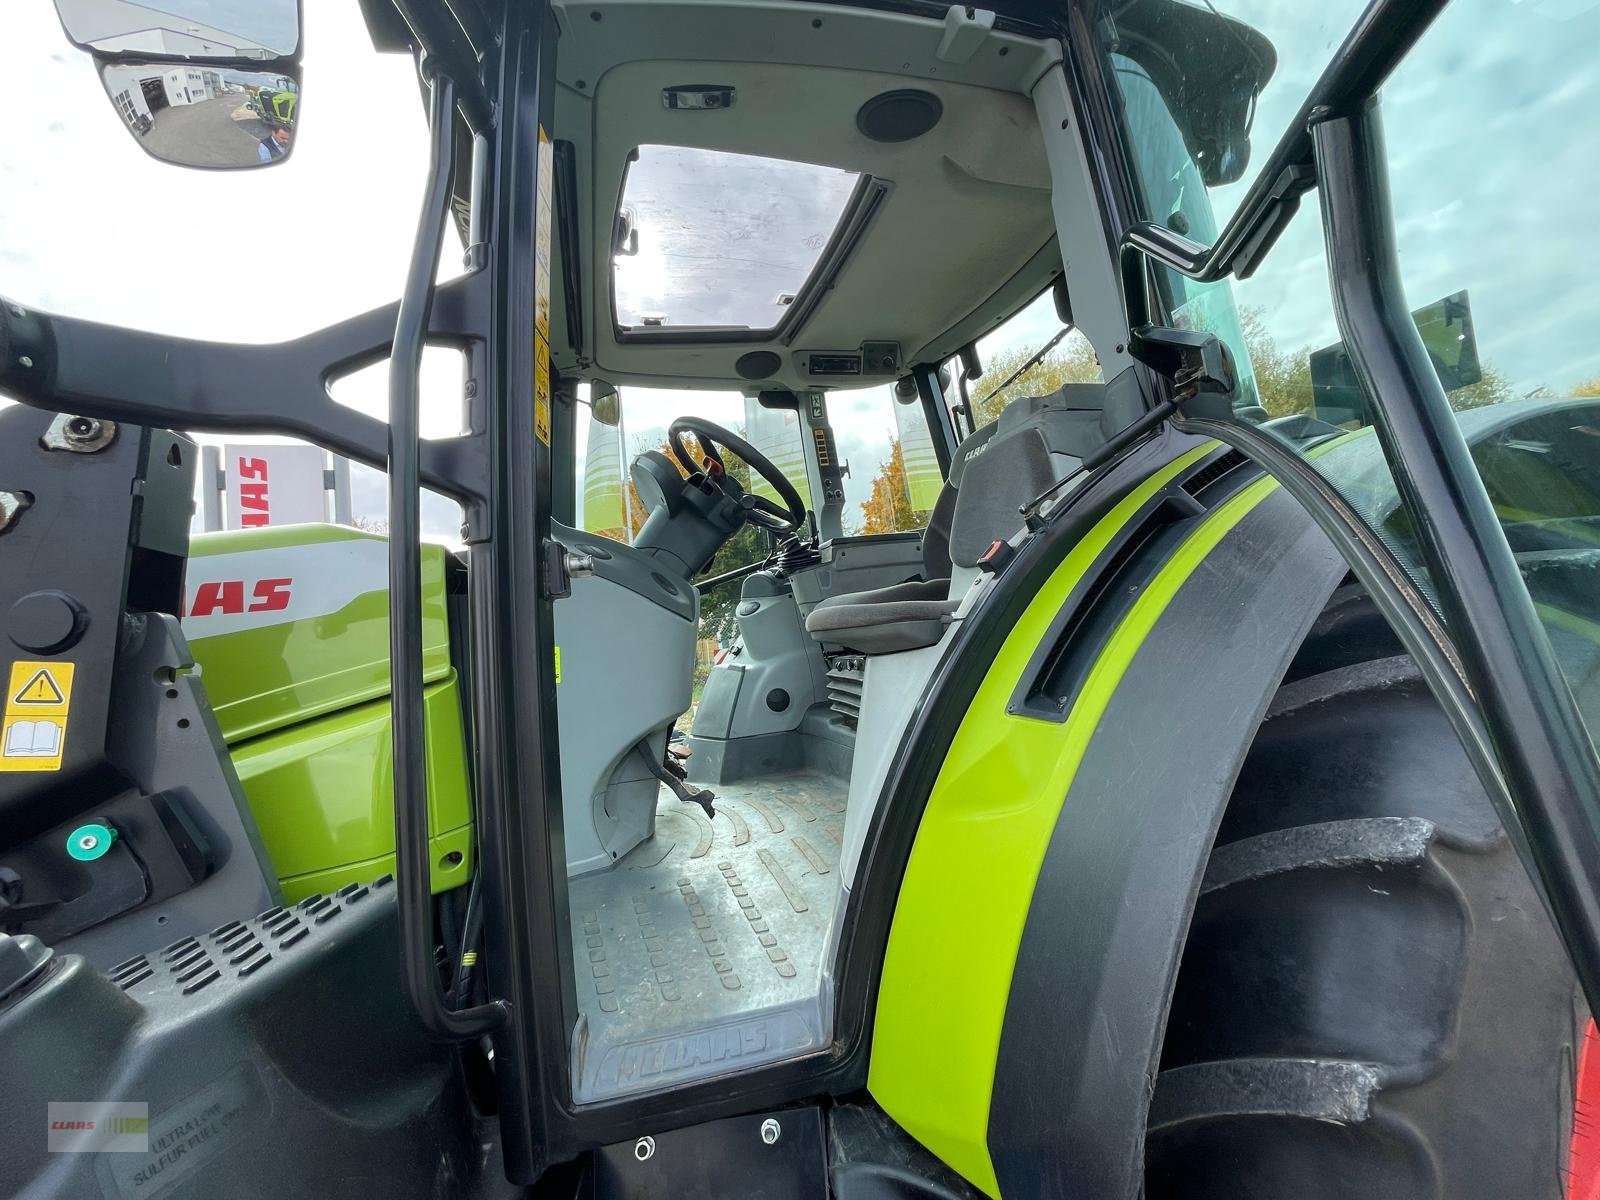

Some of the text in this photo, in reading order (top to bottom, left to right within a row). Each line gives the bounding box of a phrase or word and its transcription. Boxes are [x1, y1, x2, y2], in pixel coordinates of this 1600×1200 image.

[182, 578, 293, 618] AS
[152, 1121, 194, 1154] ULTRA
[133, 1143, 188, 1186] SULFUR
